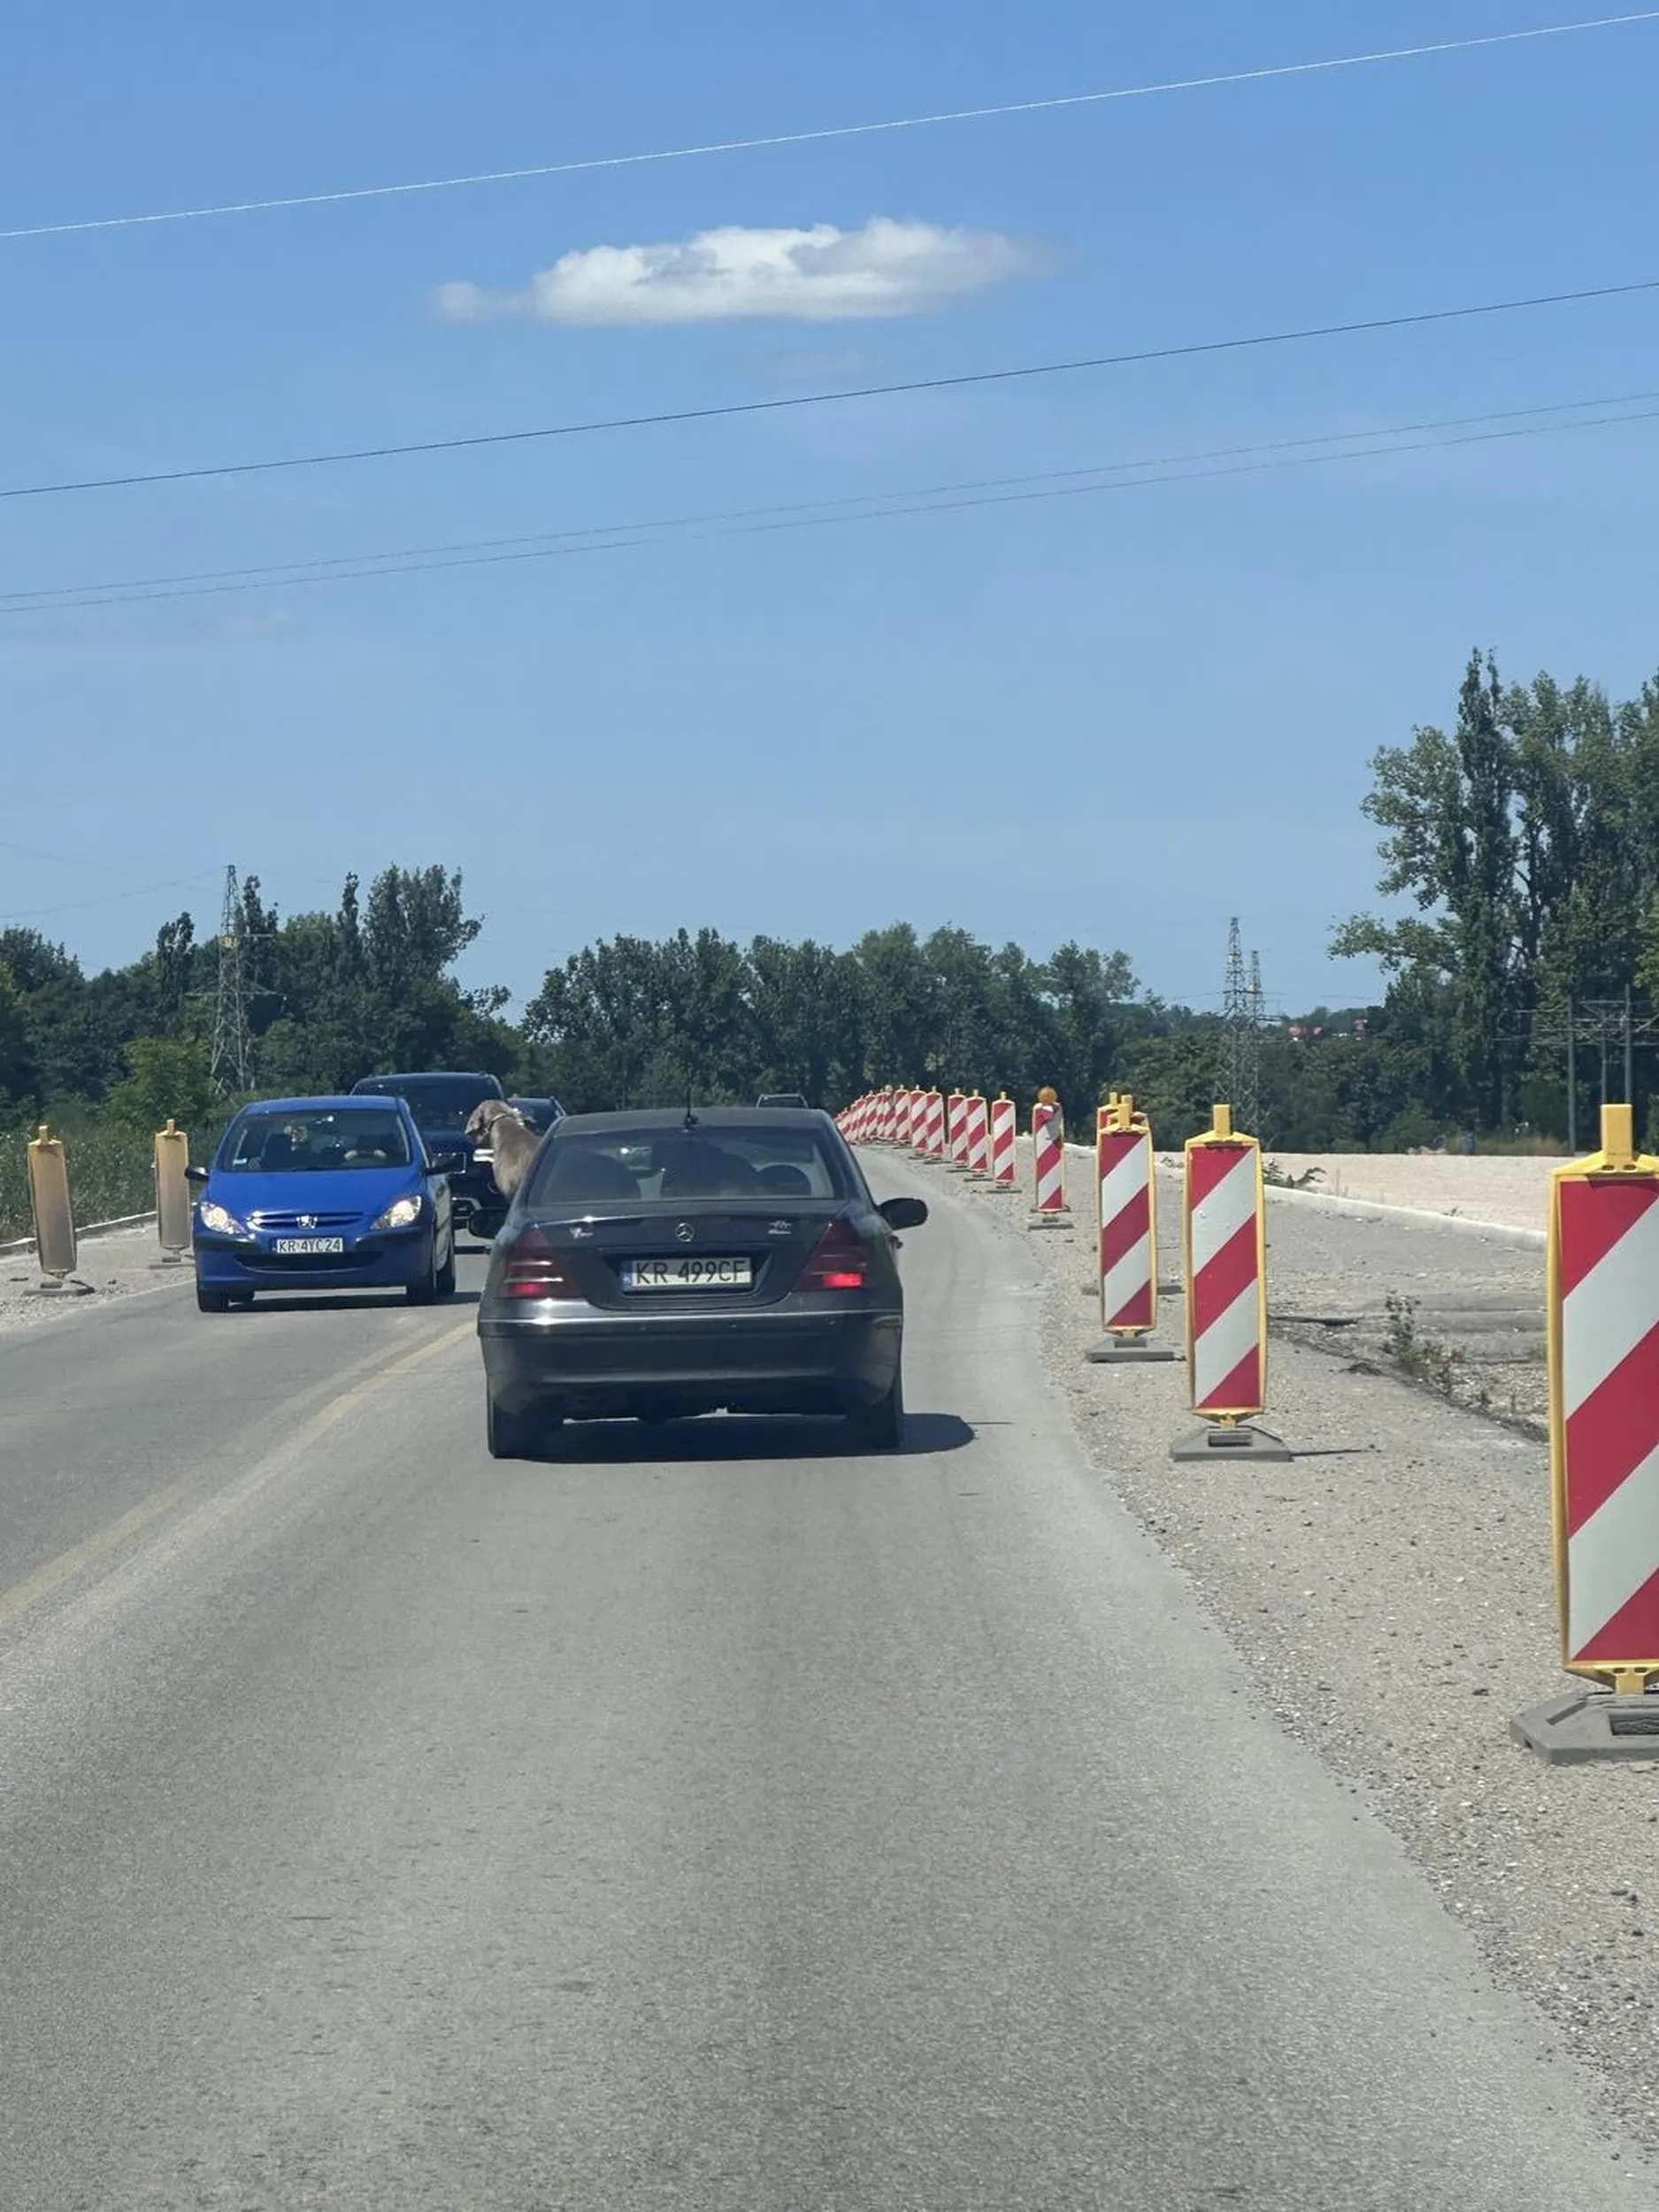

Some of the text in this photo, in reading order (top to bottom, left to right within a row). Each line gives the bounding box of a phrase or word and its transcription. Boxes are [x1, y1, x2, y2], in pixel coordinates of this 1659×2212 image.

[279, 1240, 296, 1252] KR
[635, 1260, 746, 1284] KR 499CF
